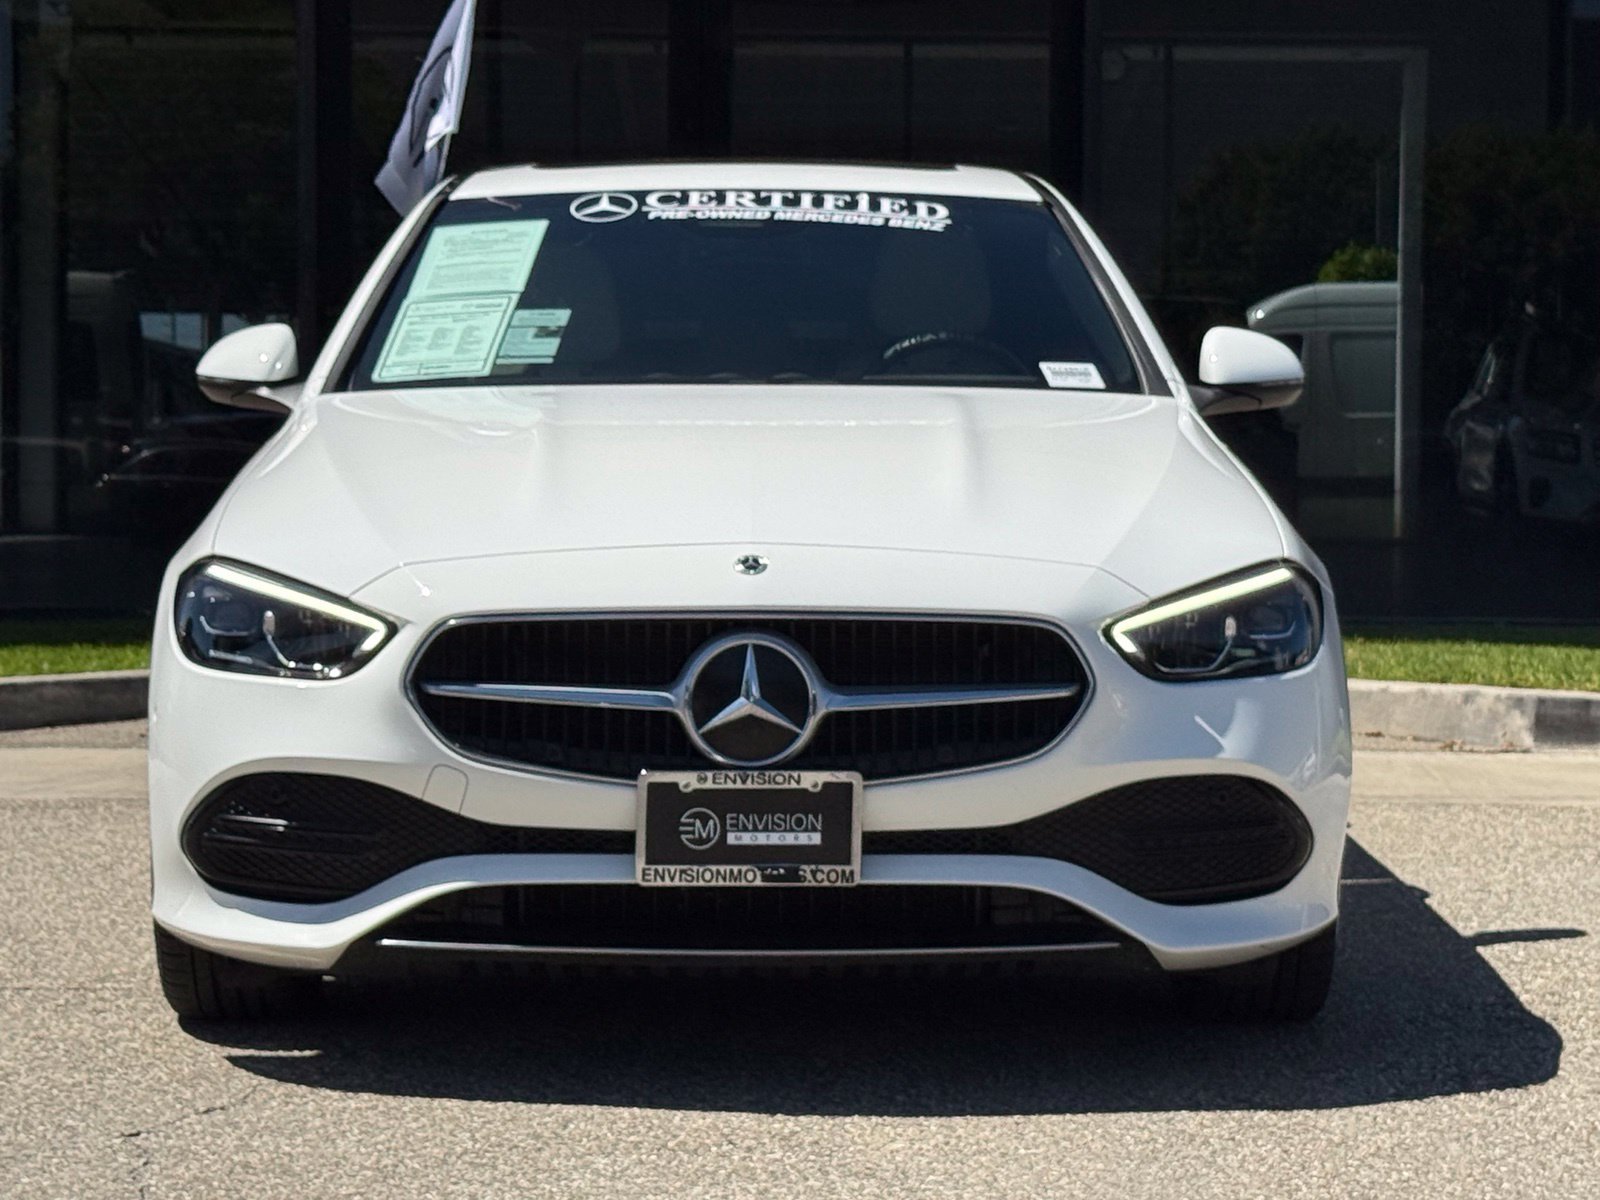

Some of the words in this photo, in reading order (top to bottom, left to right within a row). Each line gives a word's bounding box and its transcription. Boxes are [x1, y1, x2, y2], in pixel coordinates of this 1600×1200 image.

[648, 210, 771, 220] PRE-OWNED
[773, 210, 885, 226] MERCEDES
[887, 217, 947, 232] BENZ
[711, 771, 802, 785] ENVISION
[726, 813, 823, 831] ENVISION
[734, 834, 813, 842] MOTORS
[641, 867, 855, 884] ENVISIONMOS.COM
